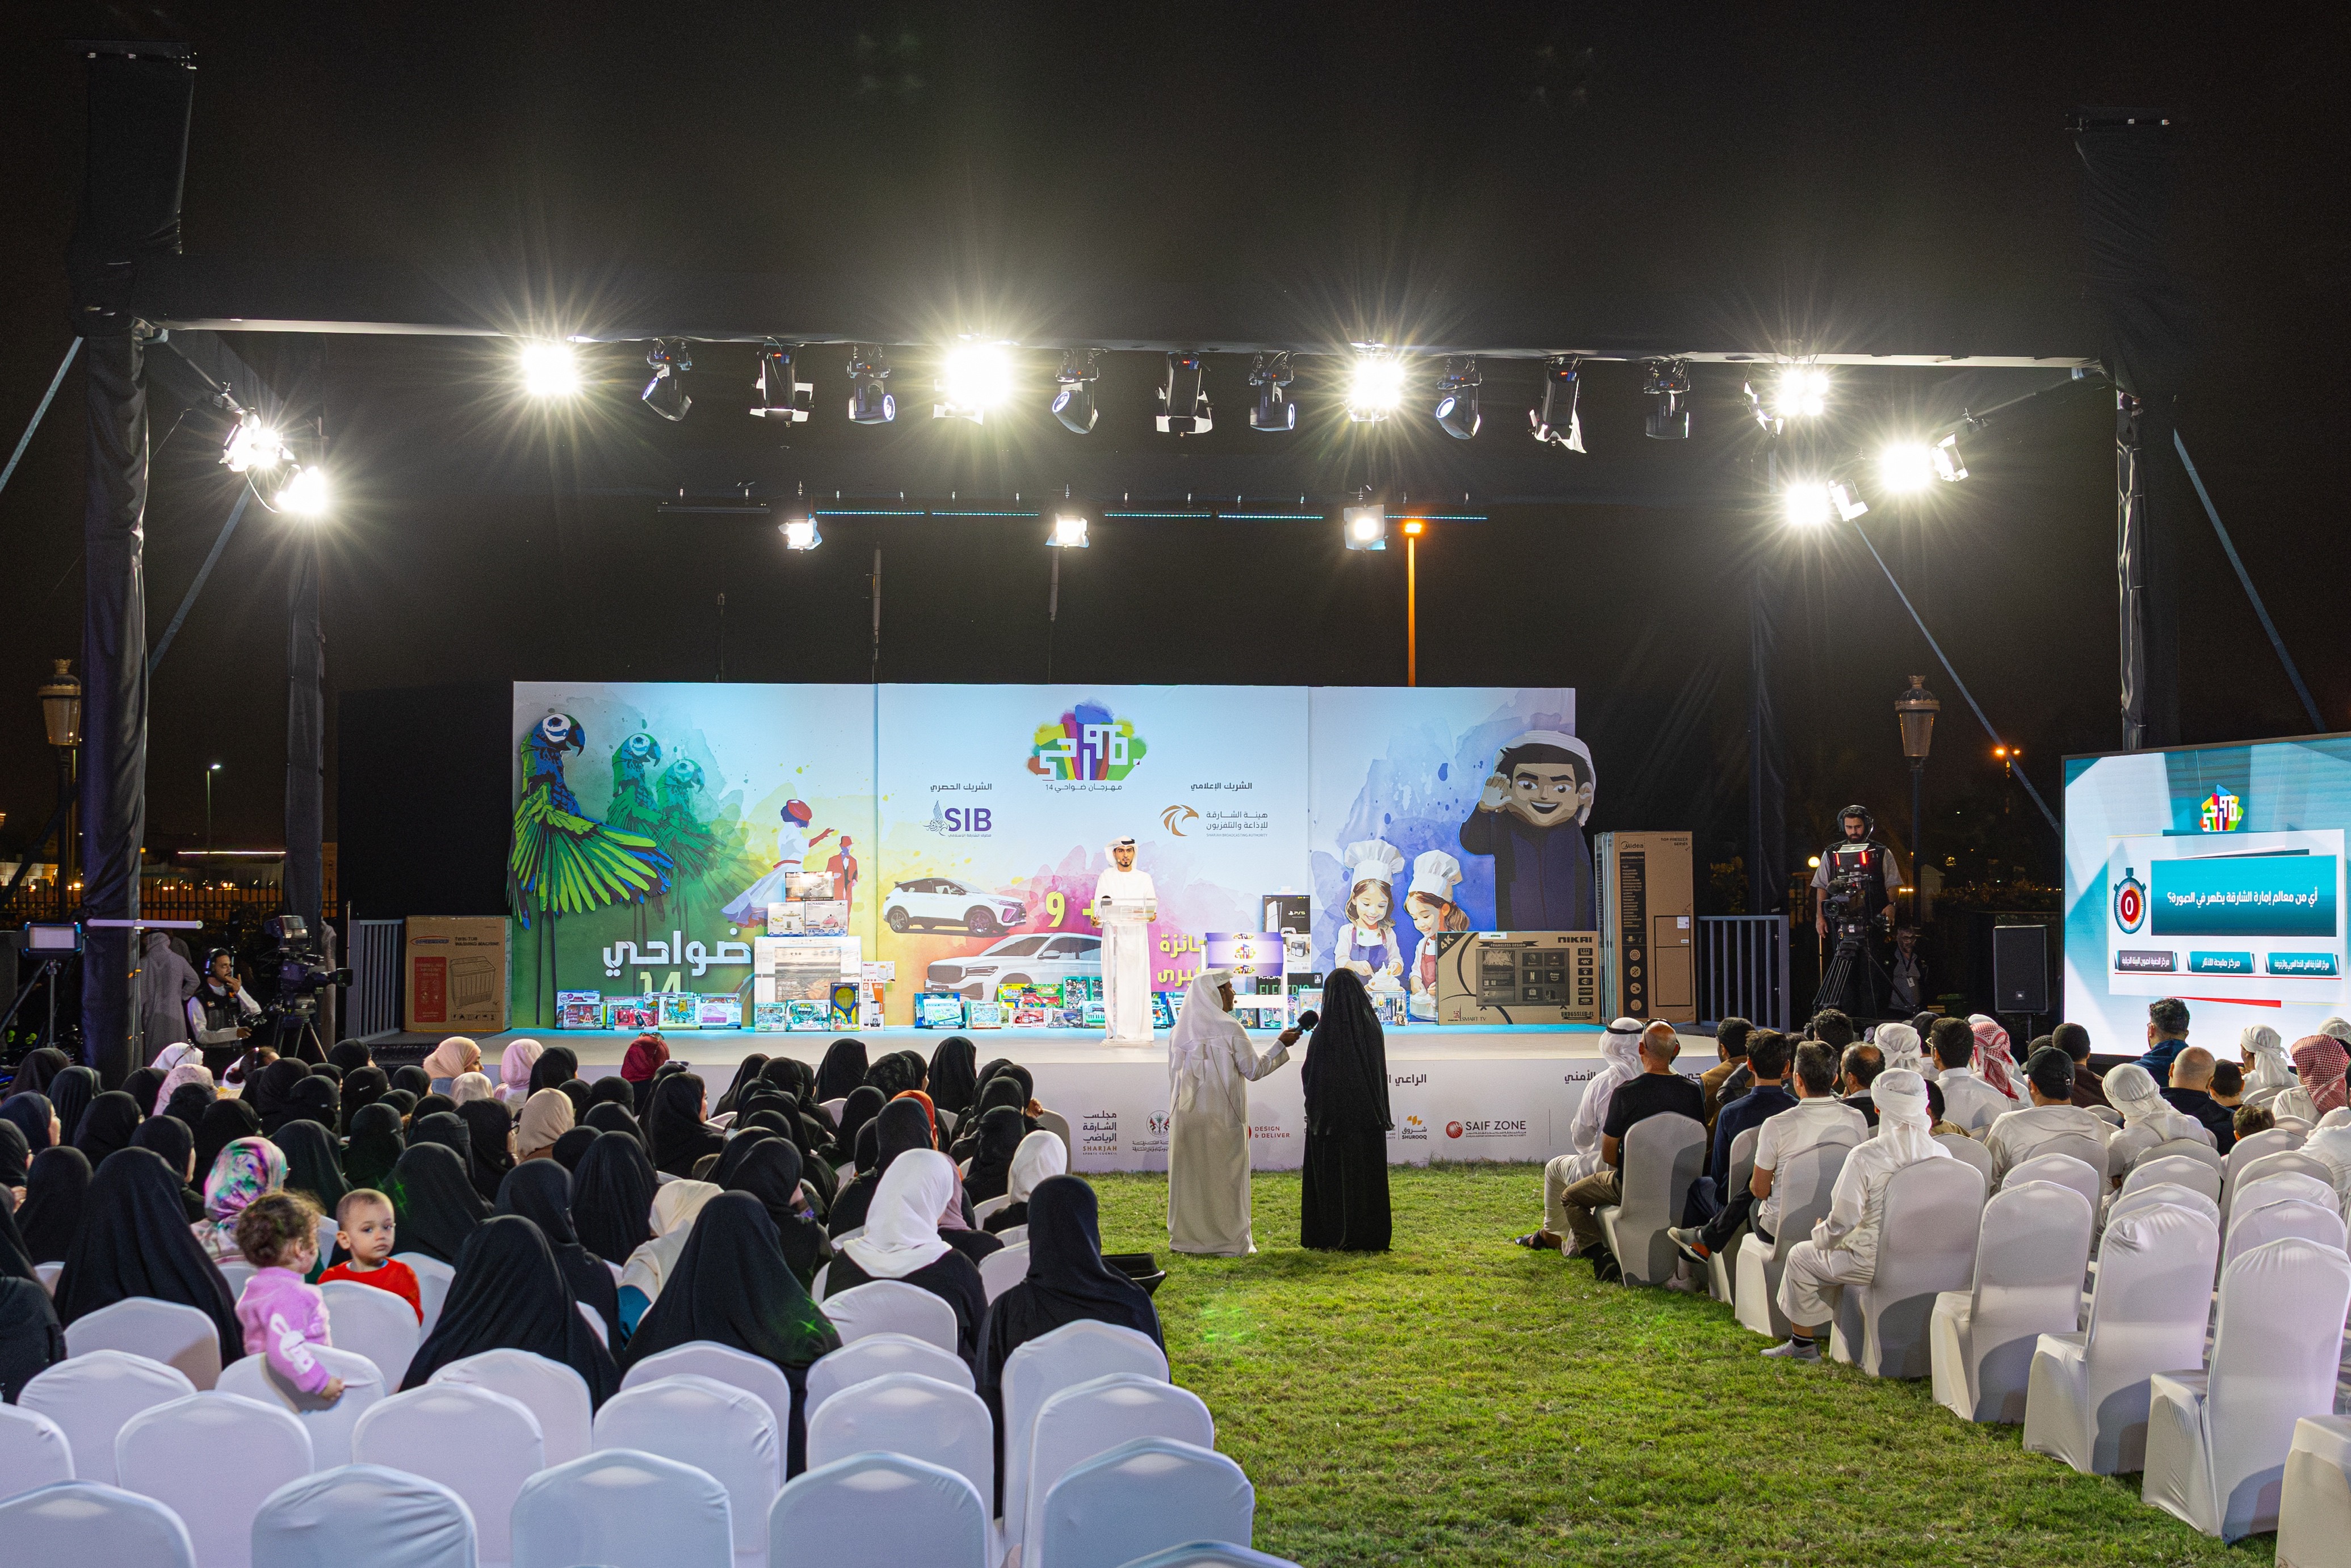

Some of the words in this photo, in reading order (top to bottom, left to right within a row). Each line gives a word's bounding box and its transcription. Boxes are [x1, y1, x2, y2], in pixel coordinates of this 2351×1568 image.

[930, 783, 960, 792] الحصري
[963, 781, 992, 792] الشريك
[1055, 783, 1086, 793] ضواحي
[1191, 782, 1221, 791] الإعلامي
[1224, 781, 1252, 791] الشريك
[944, 808, 992, 832] SIB
[1206, 810, 1242, 821] الشارقة
[1244, 811, 1268, 819] هيئة
[1206, 821, 1242, 830] والتلفزيون
[1244, 821, 1268, 830] للإذاعة
[1621, 841, 1644, 850] Midea
[2167, 892, 2195, 906] الصورة؟
[2196, 892, 2205, 908] في
[2206, 892, 2225, 906] يظهر
[2226, 890, 2252, 906] الشارقة
[2253, 890, 2272, 906] إمارة
[2272, 890, 2294, 906] معالم
[2295, 893, 2307, 905] من
[2308, 886, 2318, 907] أي
[1046, 891, 1065, 927] 9
[2125, 896, 2134, 915] 0
[1160, 934, 1204, 958] ائزة
[1441, 934, 1454, 949] 4K
[603, 927, 752, 977] ضواحي
[2214, 958, 2227, 968] مليحة
[2228, 958, 2240, 968] مركز
[1158, 965, 1200, 987] برى
[1395, 1074, 1427, 1086] الراعي
[1082, 1110, 1116, 1120] مجلس
[1083, 1121, 1116, 1132] الشارقة
[1401, 1126, 1427, 1134] شروق
[1466, 1121, 1491, 1130] SAIF
[1494, 1120, 1526, 1130] ZONE
[1083, 1133, 1116, 1144] الرياضي
